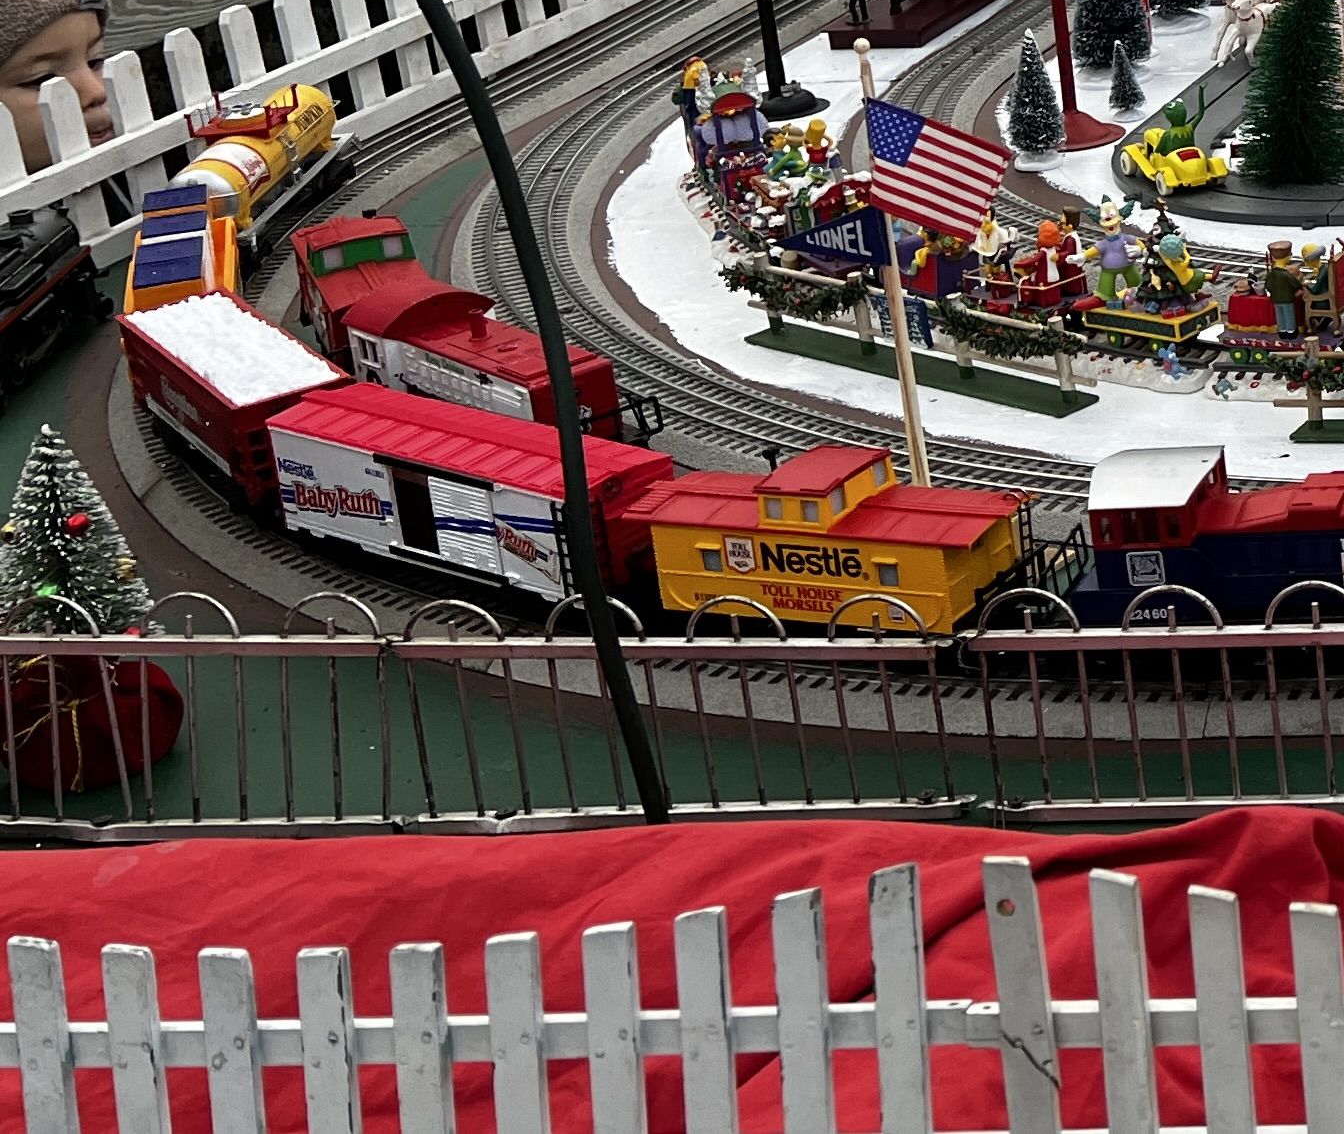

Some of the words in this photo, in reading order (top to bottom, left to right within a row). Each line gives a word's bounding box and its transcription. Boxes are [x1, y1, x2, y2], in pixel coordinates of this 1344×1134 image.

[806, 220, 872, 257] LIONEL
[760, 583, 793, 597] TOLL
[796, 587, 843, 602] HOUSE
[773, 597, 834, 613] MORSELS
